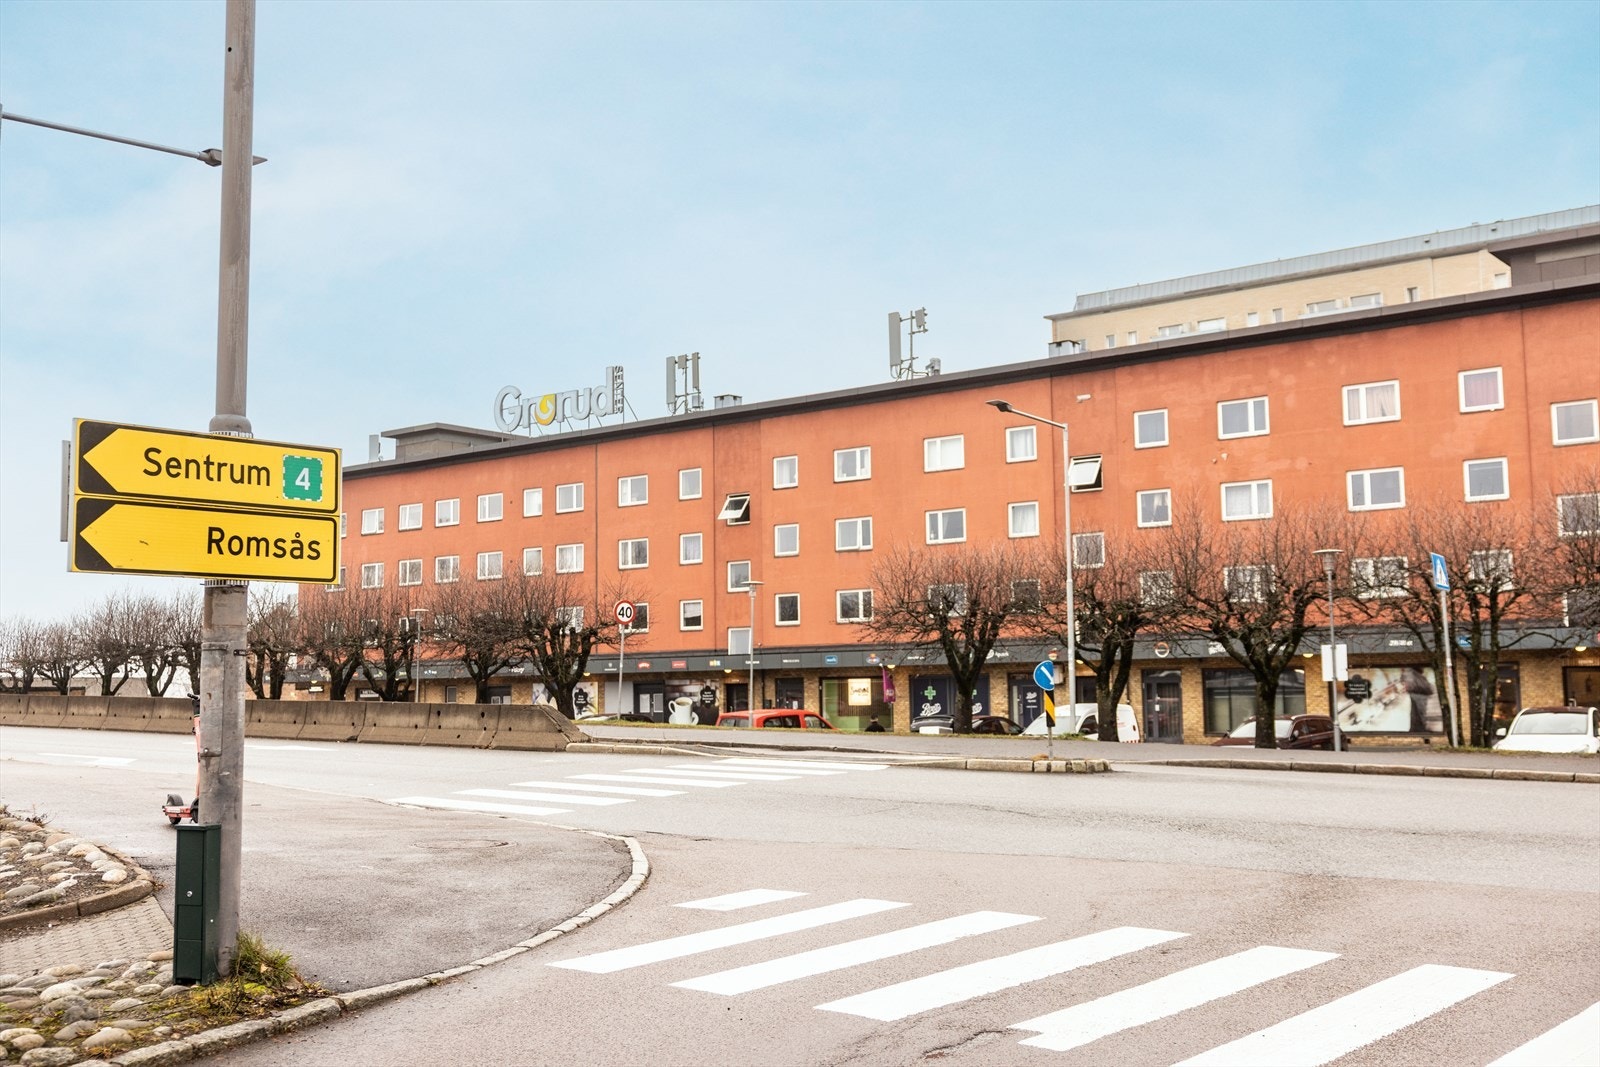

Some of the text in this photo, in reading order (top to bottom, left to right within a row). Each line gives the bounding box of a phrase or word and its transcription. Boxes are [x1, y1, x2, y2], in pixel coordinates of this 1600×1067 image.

[494, 366, 614, 432] Grorud
[143, 447, 311, 491] Sentrum 4
[207, 526, 321, 561] Romsås
[618, 606, 633, 619] 40
